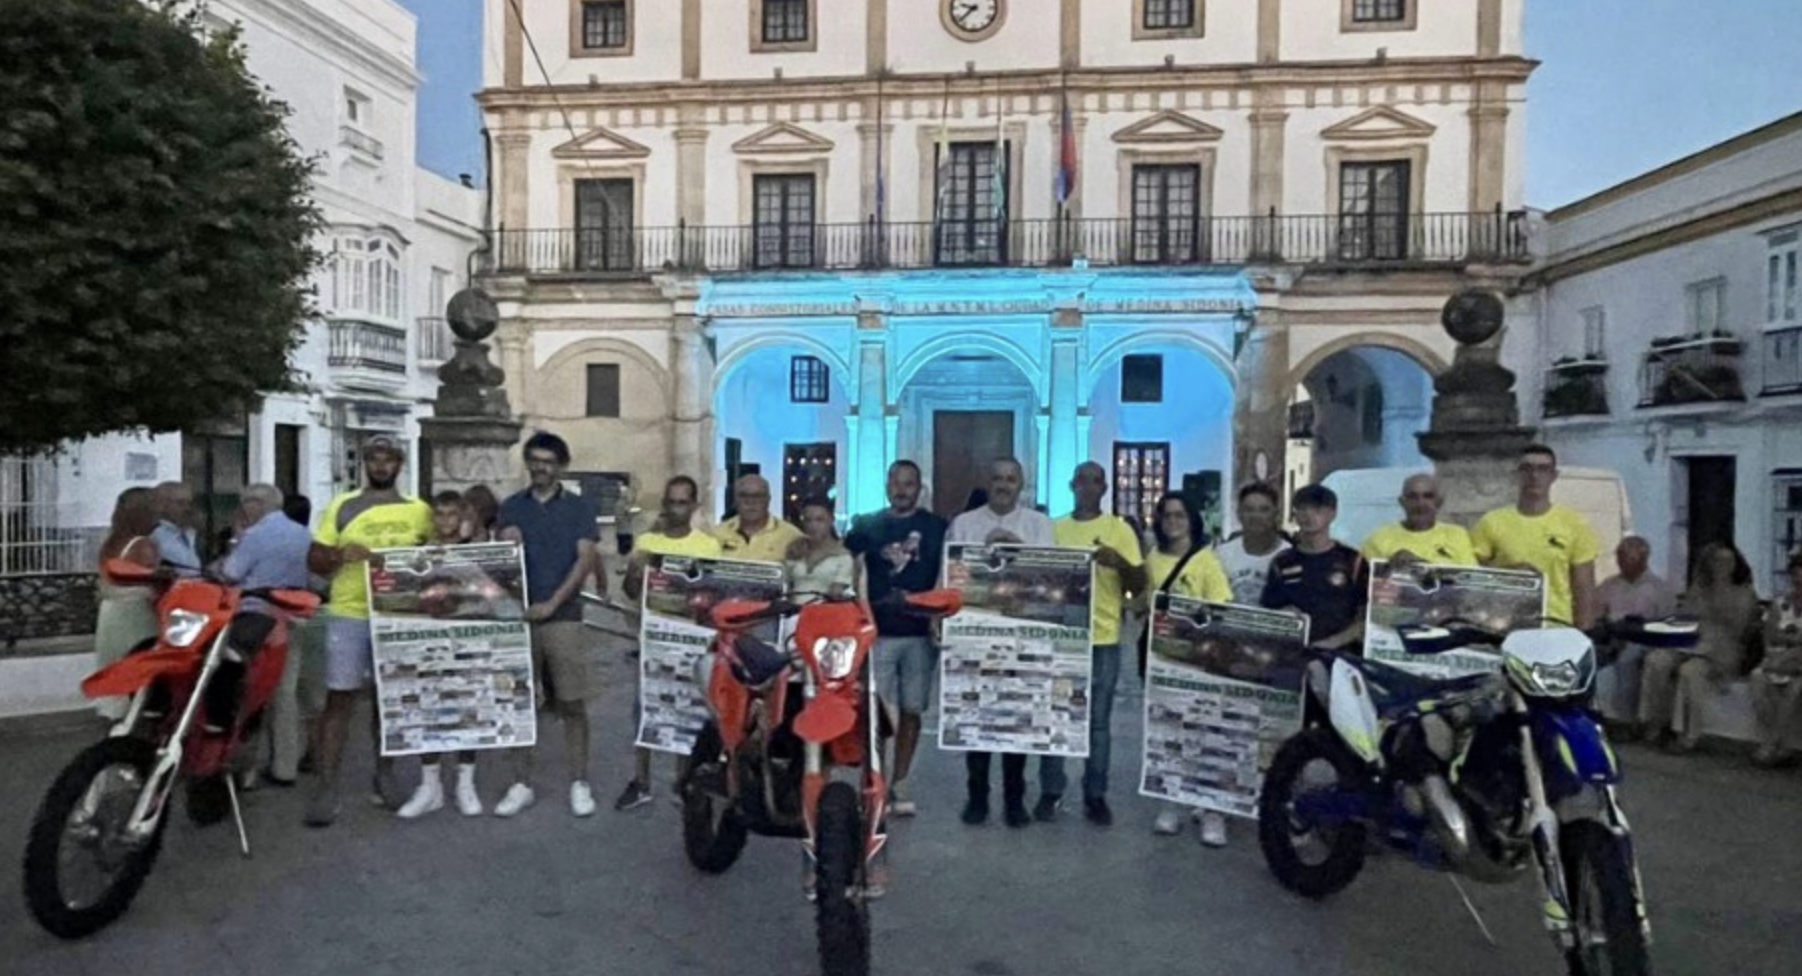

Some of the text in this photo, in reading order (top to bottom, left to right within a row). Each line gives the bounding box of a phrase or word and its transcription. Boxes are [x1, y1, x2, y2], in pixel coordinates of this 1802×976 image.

[1116, 298, 1174, 312] MEDINA
[376, 623, 525, 642] MEDINA SIDONIA
[645, 629, 708, 647] MEDINA
[950, 625, 1089, 641] MEDINA SIDONIA
[1371, 648, 1501, 668] MEDINA SIDO
[1151, 675, 1300, 704] MEDINA SIDONIA
